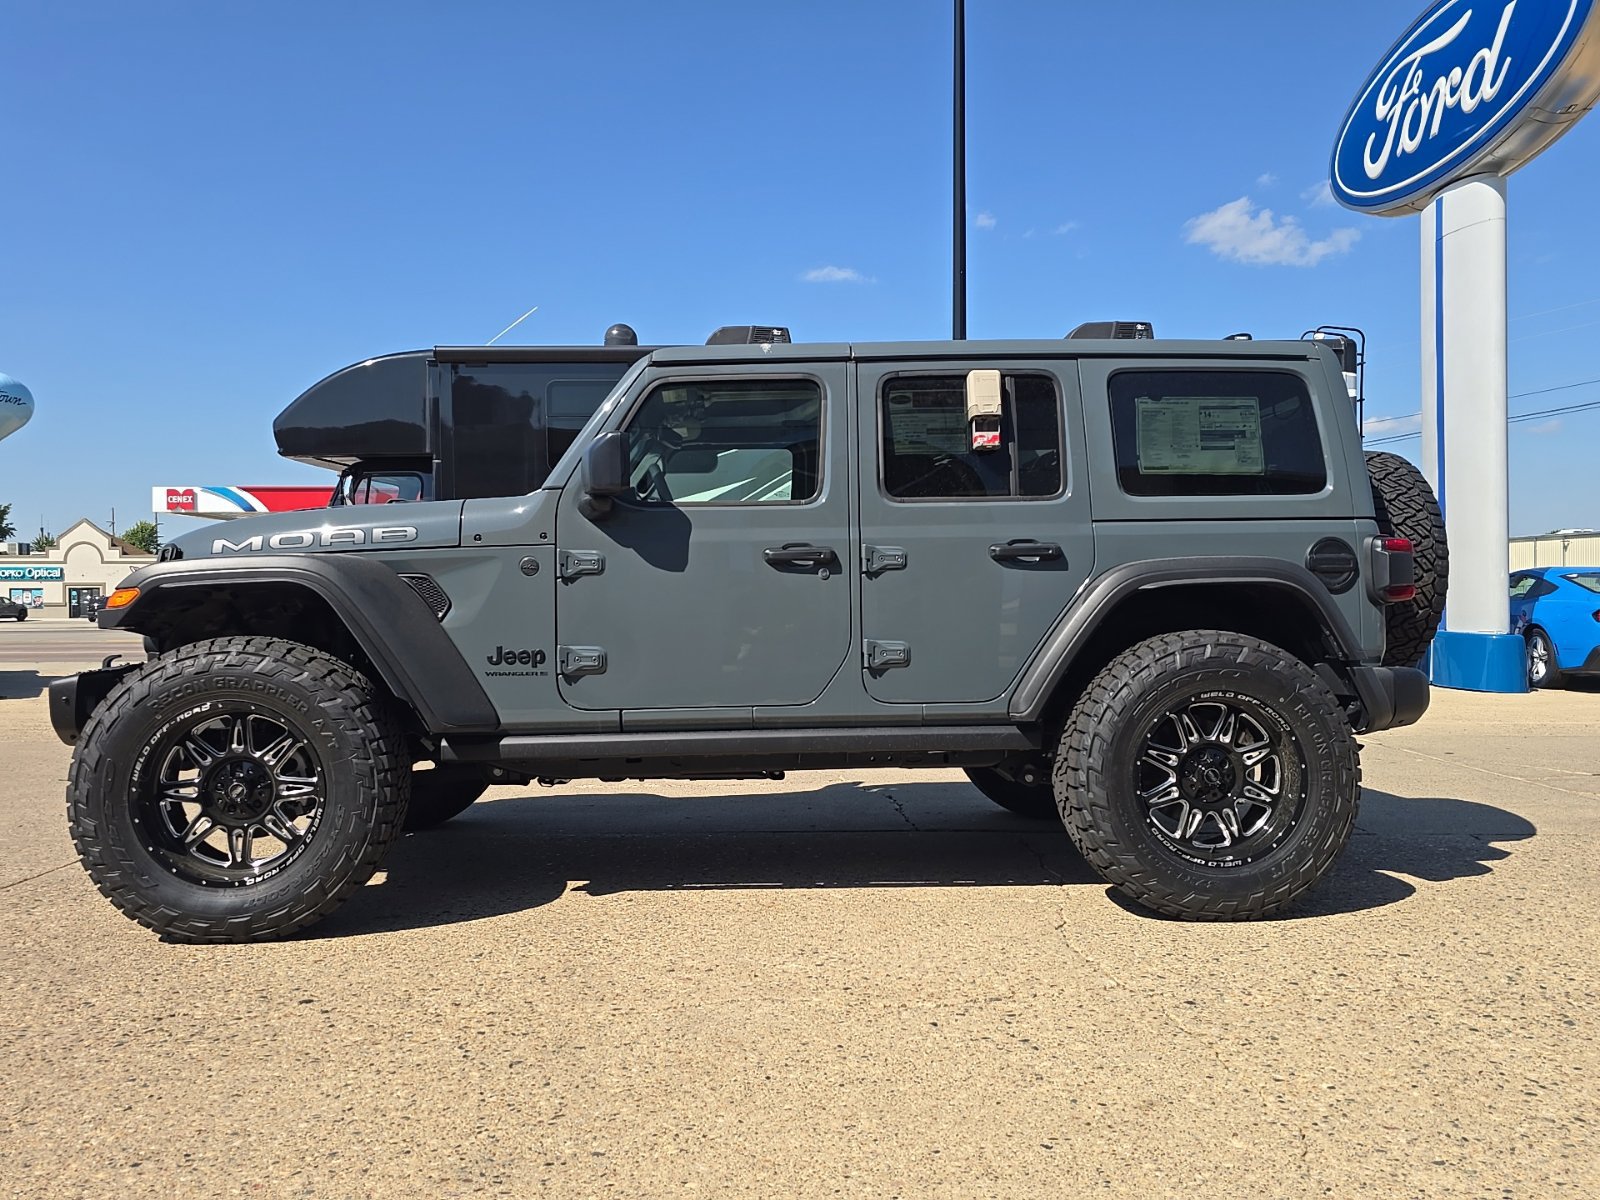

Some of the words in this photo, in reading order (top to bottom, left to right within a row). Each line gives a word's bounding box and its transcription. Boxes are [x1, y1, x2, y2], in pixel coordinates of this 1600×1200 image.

[1363, 0, 1517, 179] Ford
[168, 495, 193, 503] CENEX
[211, 526, 418, 554] MOAB
[25, 567, 61, 580] Optical
[486, 645, 546, 668] Jeep
[1200, 691, 1235, 699] WELD
[1237, 694, 1291, 731] OFF-ROAD
[132, 745, 151, 782] WELD
[150, 702, 212, 745] OFF-ROAD
[305, 807, 323, 844] WELD
[1151, 827, 1206, 865] OFF-ROAD
[1208, 859, 1242, 867] WELD
[246, 844, 305, 886] OFF-ROAD
